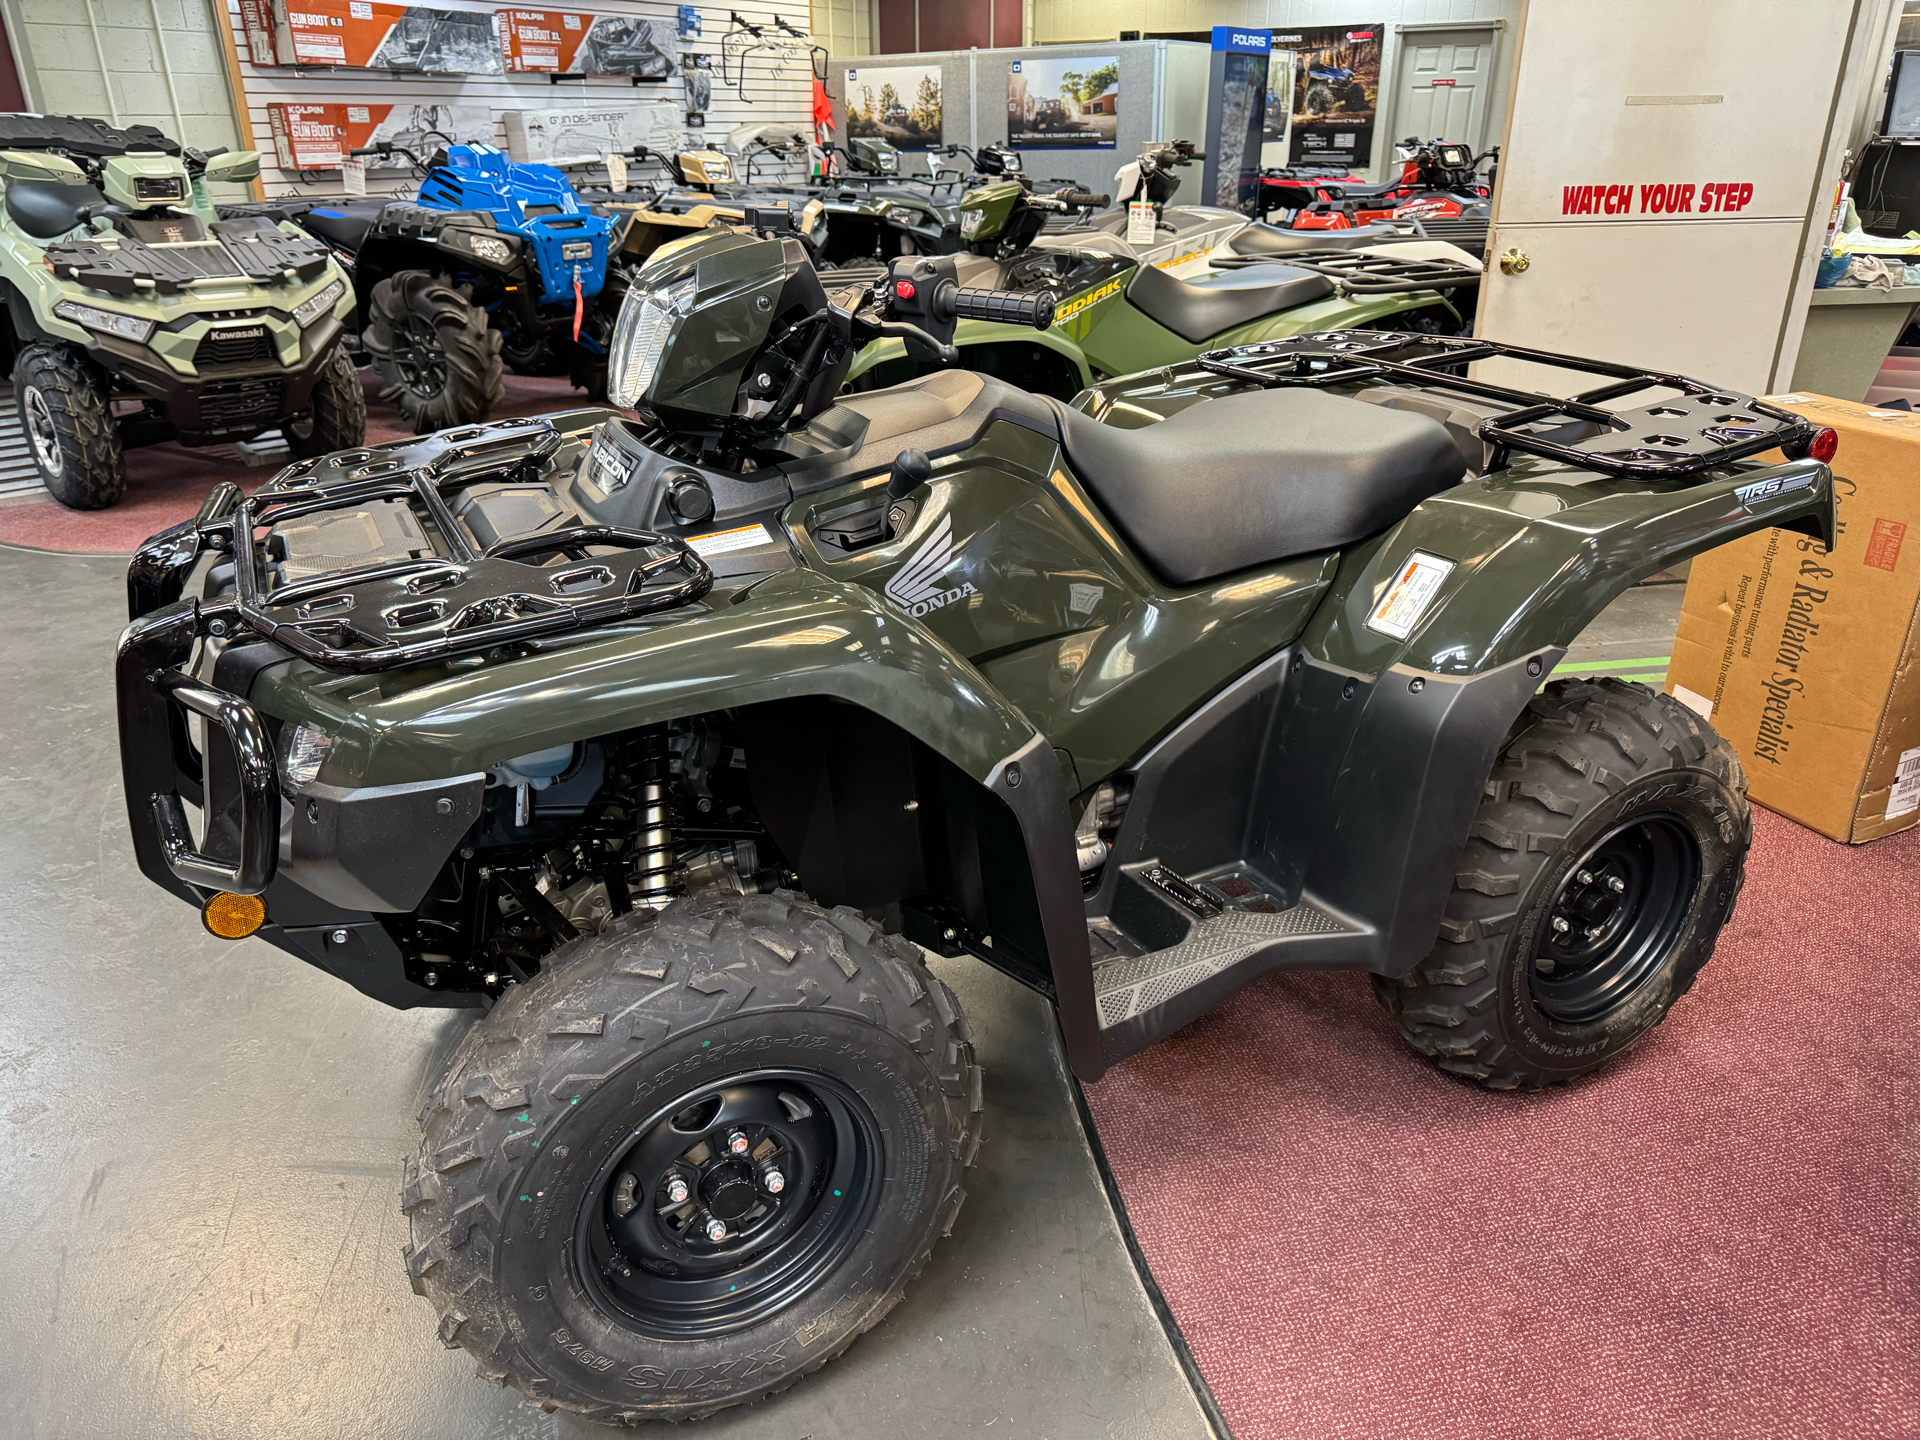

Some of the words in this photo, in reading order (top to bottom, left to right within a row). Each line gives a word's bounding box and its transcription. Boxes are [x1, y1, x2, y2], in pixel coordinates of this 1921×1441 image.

[244, 1, 258, 22] GUN
[289, 12, 308, 26] GUN
[308, 14, 329, 27] BOOT
[515, 12, 545, 22] KOLPIN
[518, 28, 533, 40] GUN
[533, 29, 551, 41] BOOT
[551, 31, 562, 41] XL
[1232, 33, 1267, 48] POLARIS
[1271, 34, 1302, 43] OLVERINES
[287, 106, 325, 115] KOLPIN
[573, 113, 624, 124] DEFENDER
[291, 125, 312, 137] GUN
[312, 125, 335, 137] BOOT
[1562, 184, 1634, 215] WATCH
[1640, 183, 1697, 214] YOUR
[1699, 182, 1754, 213] STEP
[1153, 246, 1213, 270] RIZZLY
[1052, 278, 1121, 324] ODIAK
[211, 327, 264, 341] Kawasaki
[1767, 538, 1780, 557] with
[1881, 537, 1900, 570] FRAGILE
[1799, 559, 1834, 581] &
[1737, 574, 1752, 605] Repeat
[1753, 556, 1773, 609] performance
[1730, 603, 1746, 639] business
[1744, 608, 1762, 637] tuning
[1776, 581, 1829, 674] Radiator
[1723, 645, 1735, 664] vital
[1741, 634, 1753, 659] parts
[1717, 671, 1727, 687] our
[1711, 685, 1724, 716] success
[1753, 672, 1805, 766] Specialist
[1615, 783, 1735, 844] MAXXIS
[624, 1262, 875, 1391] MAXXIS
[552, 1328, 615, 1372] M975
